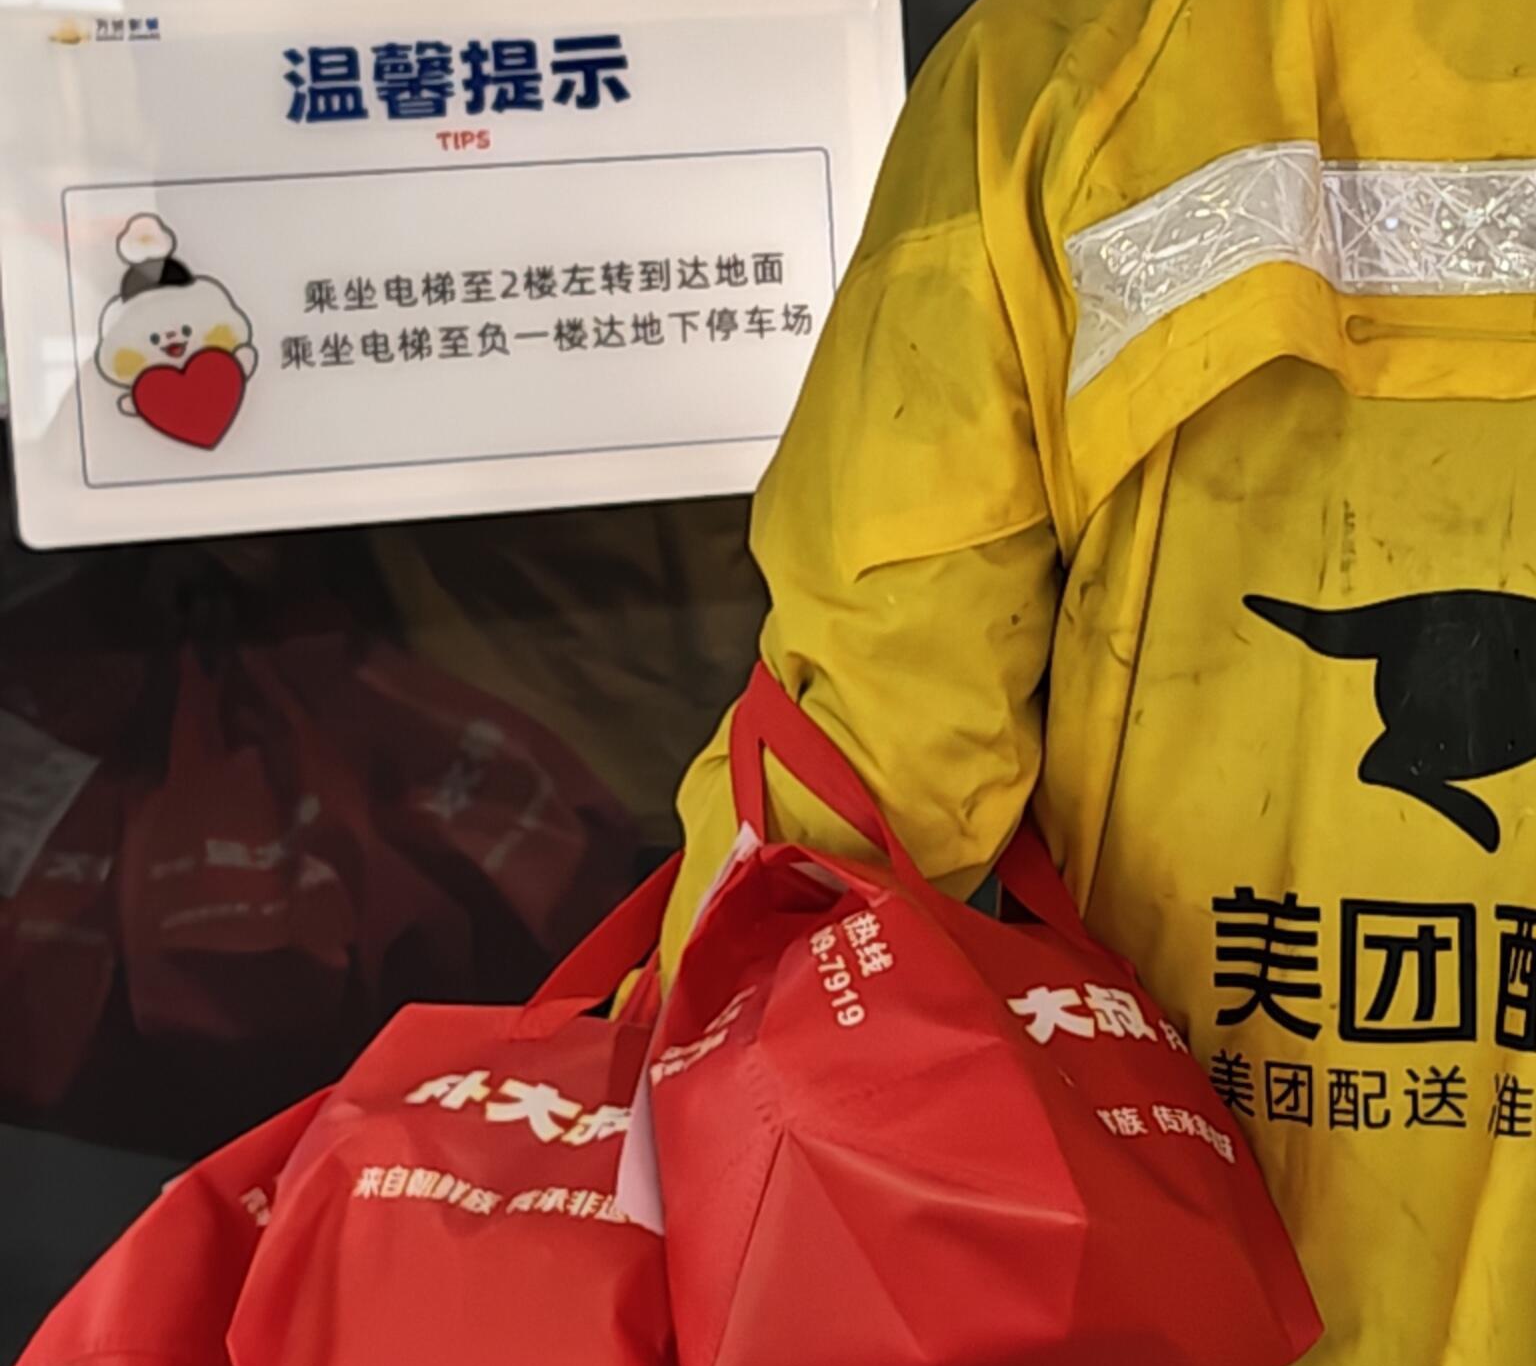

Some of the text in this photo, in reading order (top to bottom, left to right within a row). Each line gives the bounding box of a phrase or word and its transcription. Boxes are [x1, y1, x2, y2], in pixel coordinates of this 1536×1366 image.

[281, 33, 632, 124] 温馨提示
[435, 129, 492, 152] TIPS
[303, 252, 786, 314] 乘坐电梯至2楼左转到达地面
[279, 302, 815, 371] 乘坐电梯至负一楼达地下停车场
[1208, 1049, 1468, 1132] 美团配送
